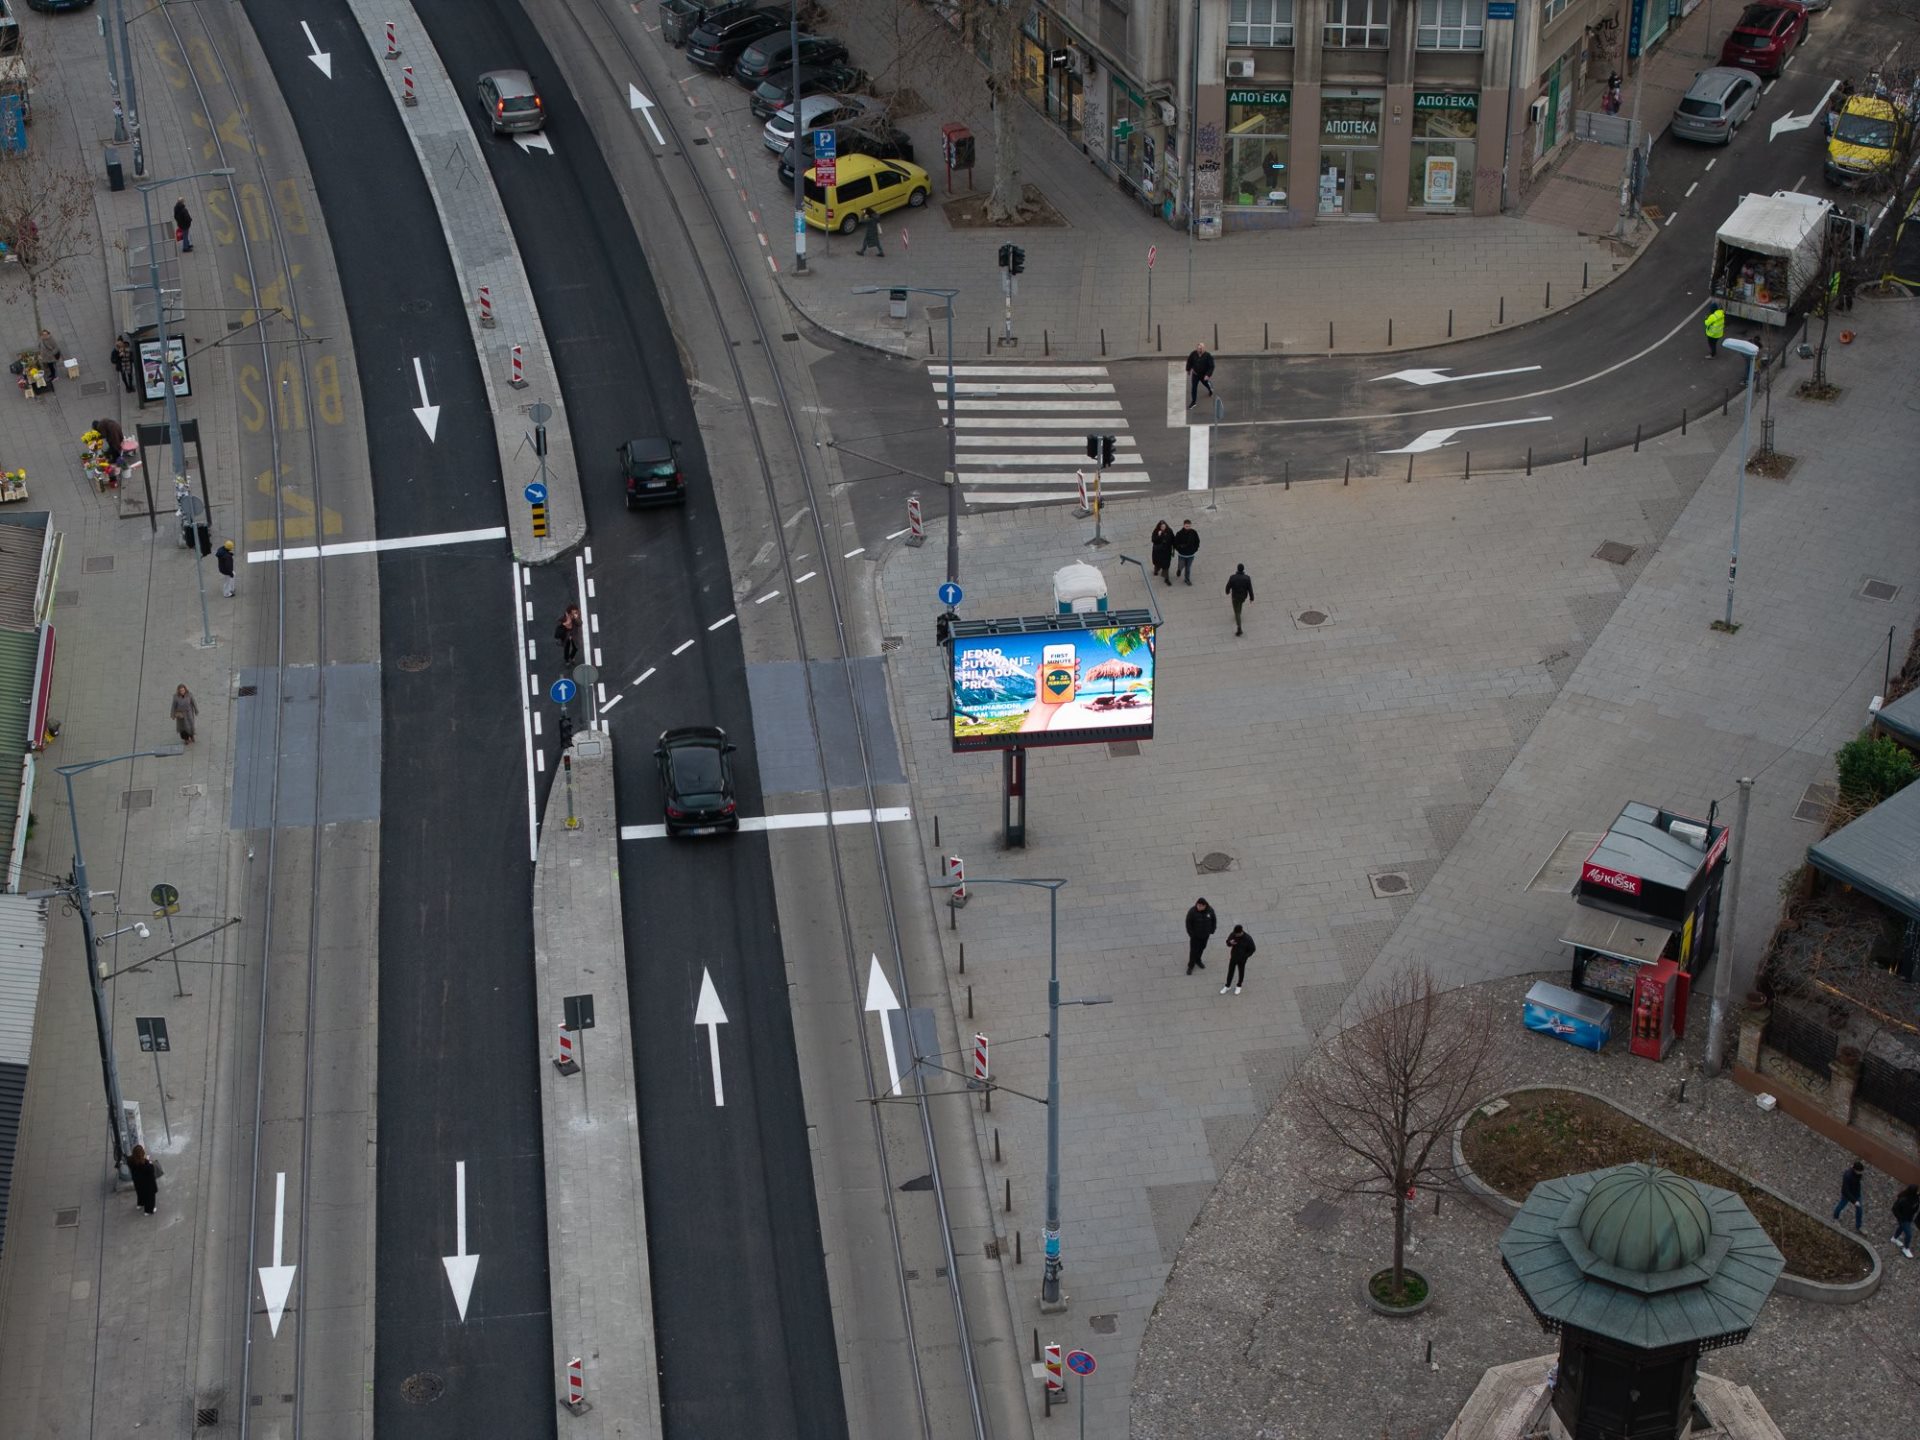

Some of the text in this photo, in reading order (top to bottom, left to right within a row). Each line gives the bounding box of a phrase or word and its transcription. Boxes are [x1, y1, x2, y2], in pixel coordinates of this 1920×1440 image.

[1230, 92, 1287, 103] АПОТЕКА
[1417, 96, 1475, 107] АПОТЕКА
[1325, 120, 1377, 134] АПОТЕКА
[819, 132, 831, 147] P
[207, 178, 310, 245] BUS
[239, 356, 344, 431] BUS
[961, 648, 1002, 661] JEDNO
[962, 656, 1034, 670] PUTOVANJE,
[962, 668, 1012, 681] HILJADU
